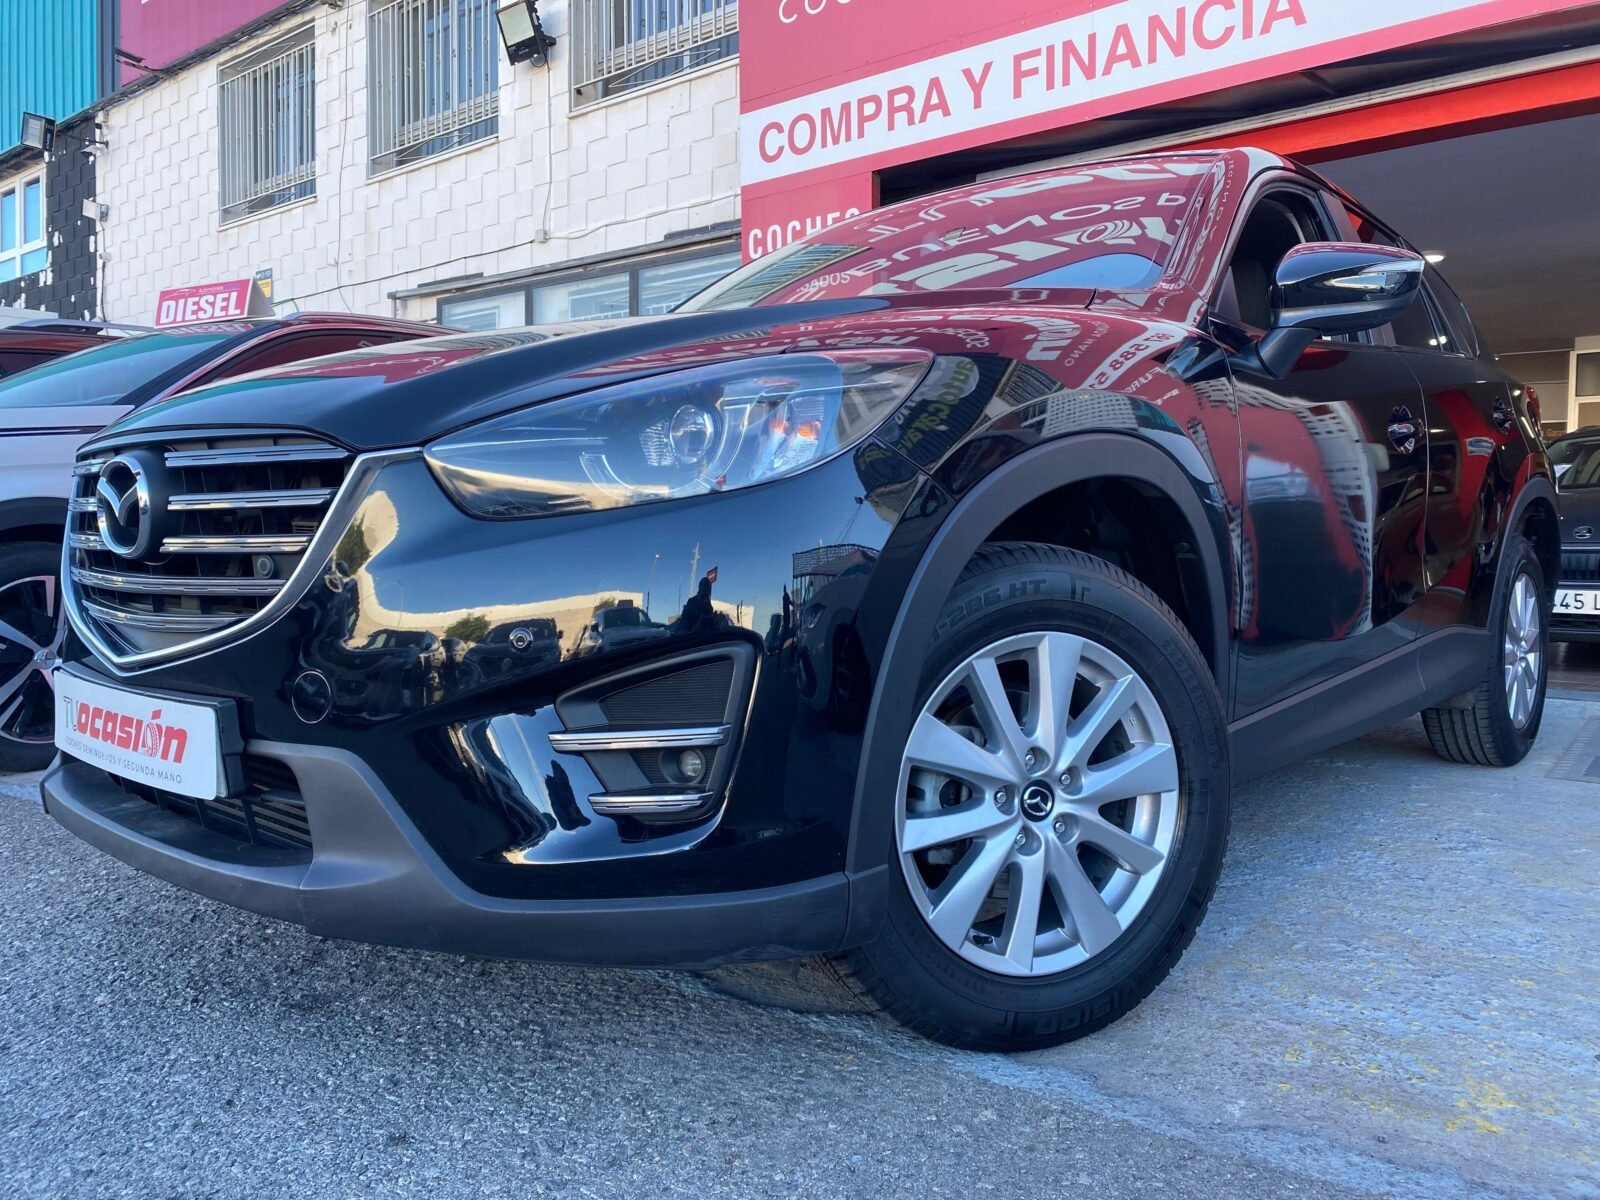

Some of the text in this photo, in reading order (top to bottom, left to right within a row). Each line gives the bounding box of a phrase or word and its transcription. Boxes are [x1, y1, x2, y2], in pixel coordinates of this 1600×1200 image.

[759, 0, 1307, 163] COMPRA Y FINANCIA
[159, 292, 241, 324] DIESEL
[1552, 592, 1584, 610] 45
[122, 758, 155, 777] SEGUNDA
[156, 770, 183, 785] MANO
